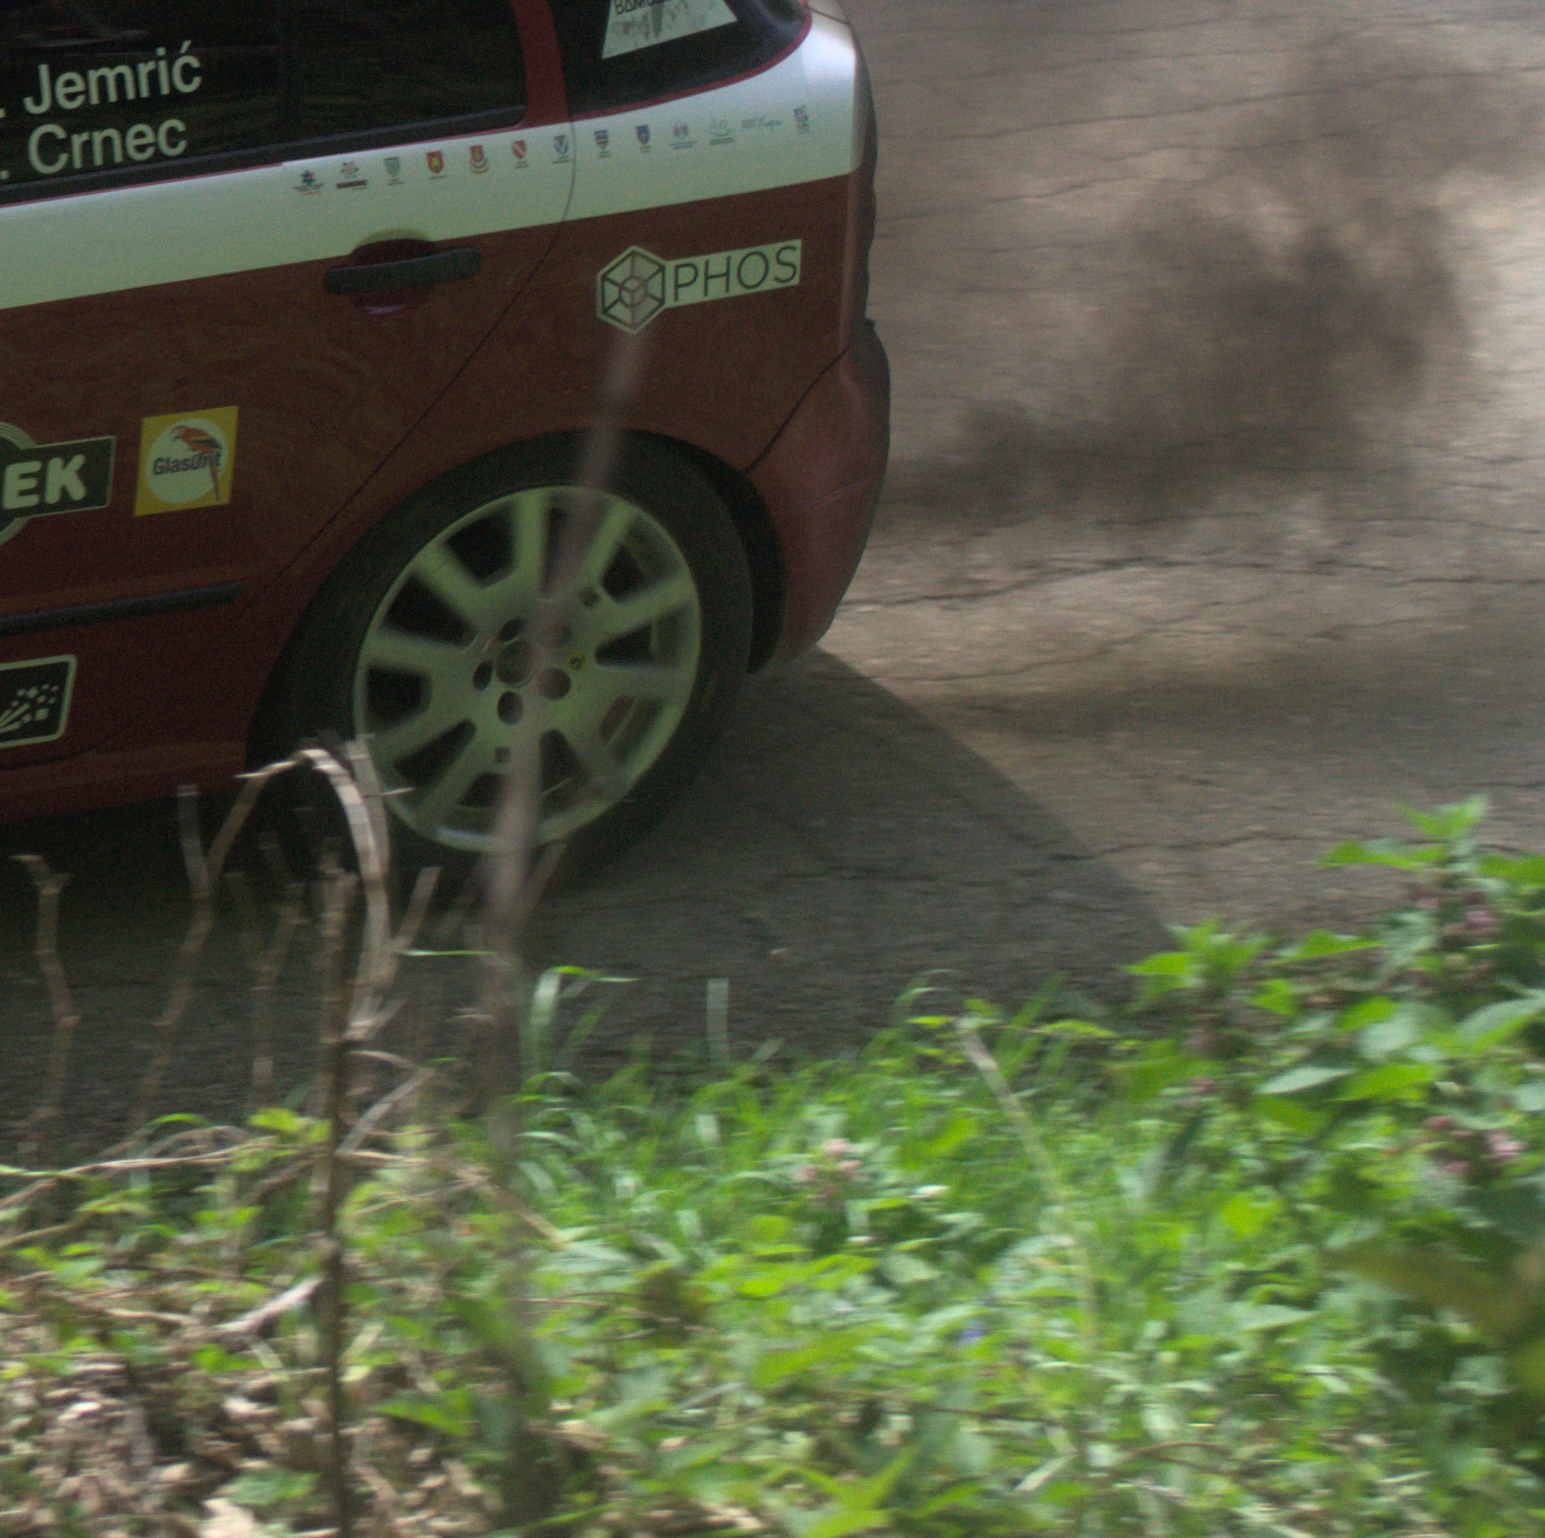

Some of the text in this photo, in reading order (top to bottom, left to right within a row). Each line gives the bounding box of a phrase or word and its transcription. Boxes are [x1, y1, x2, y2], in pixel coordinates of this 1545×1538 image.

[22, 39, 203, 115] Jemrić
[27, 119, 188, 175] Crnec
[674, 245, 798, 302] PHOS
